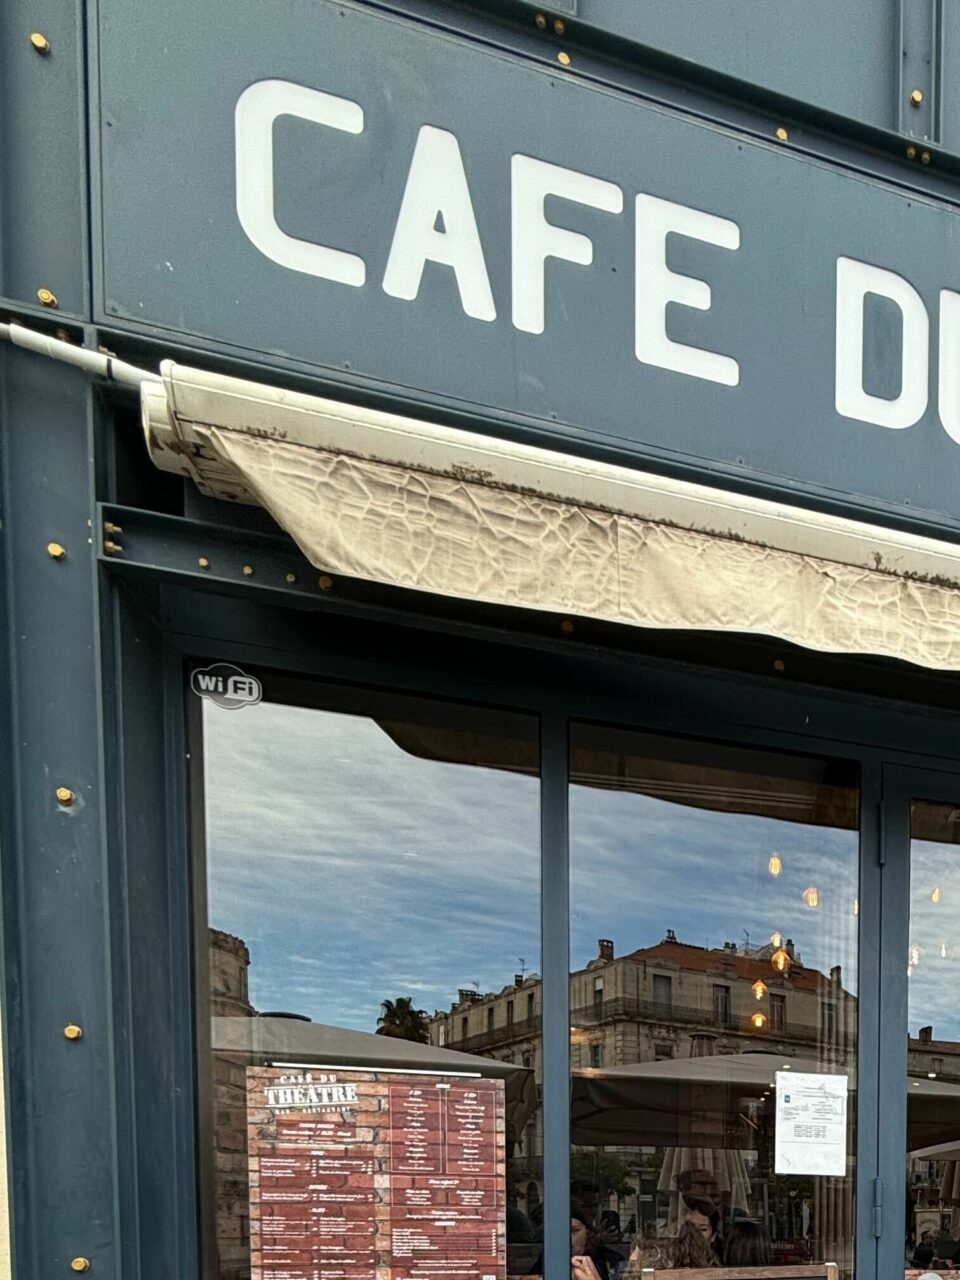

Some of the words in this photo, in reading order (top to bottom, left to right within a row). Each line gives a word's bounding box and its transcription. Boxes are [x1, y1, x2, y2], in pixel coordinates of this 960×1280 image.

[235, 78, 740, 387] CAFE
[320, 1074, 337, 1083] DU
[264, 1084, 358, 1105] THÉÂTRE
